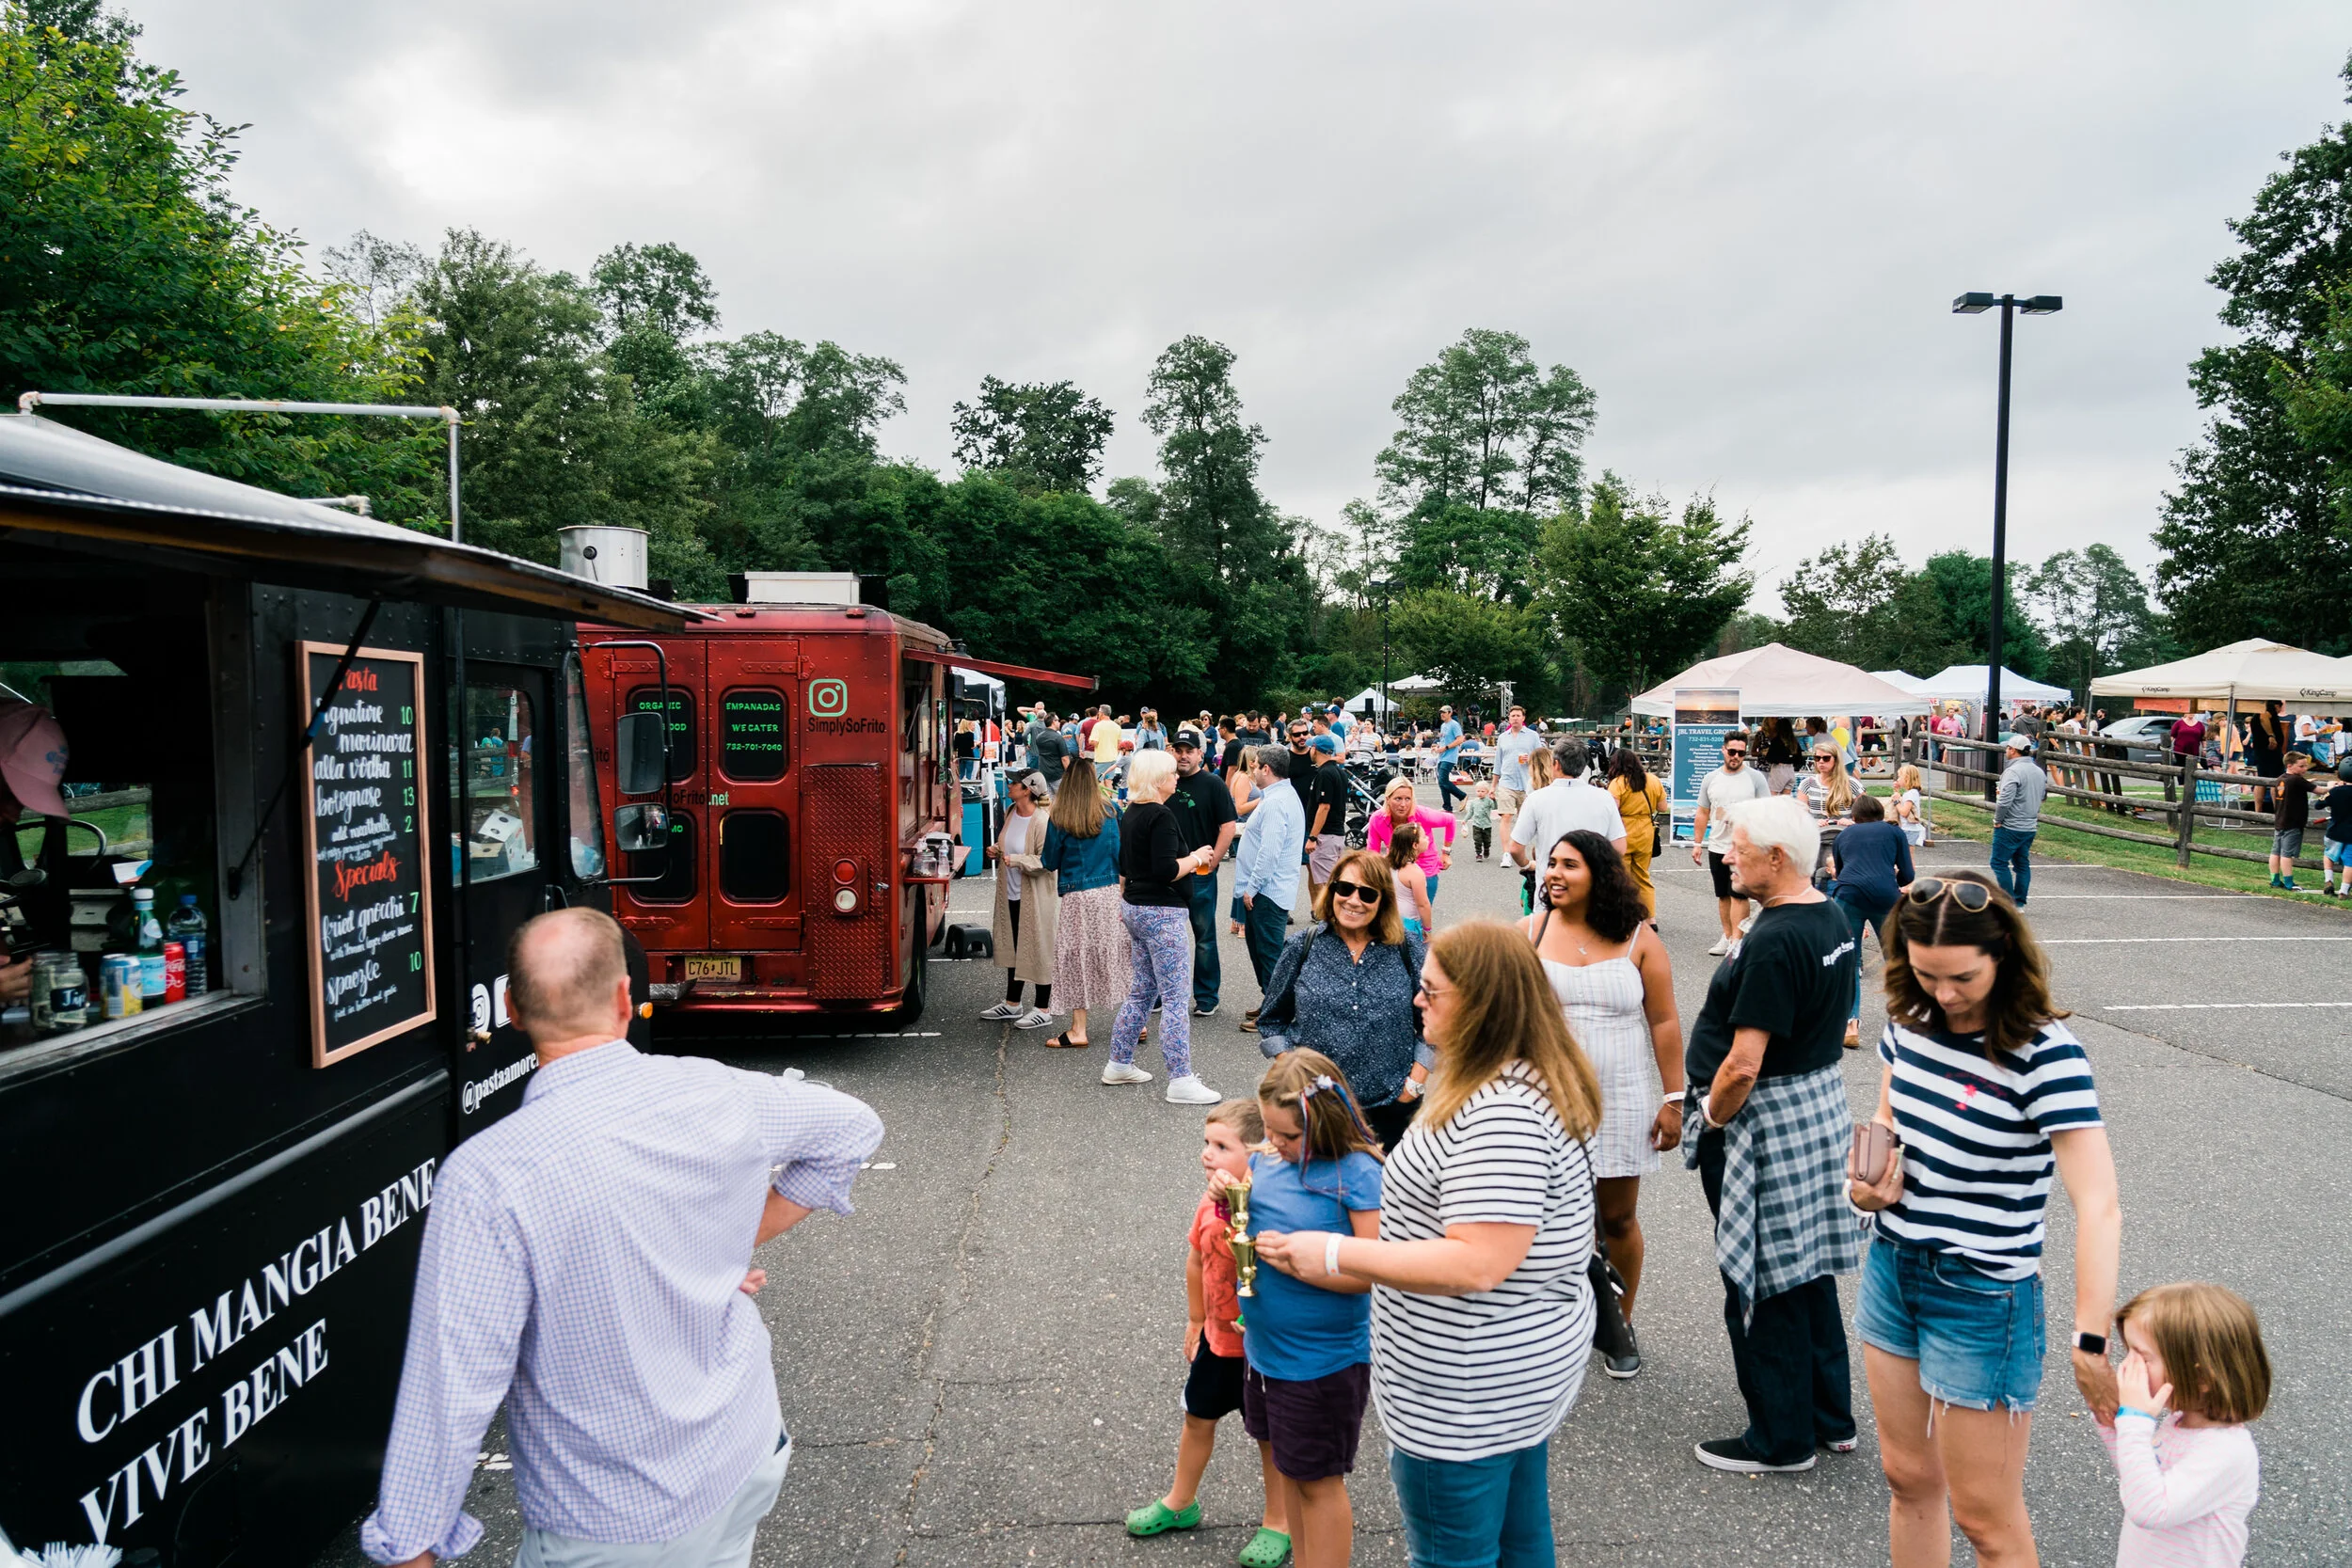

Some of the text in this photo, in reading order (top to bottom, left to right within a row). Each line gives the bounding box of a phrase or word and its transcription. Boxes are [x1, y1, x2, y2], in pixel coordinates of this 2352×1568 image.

[339, 660, 378, 691] asta
[316, 698, 413, 736] ignature 10
[725, 703, 781, 711] EMPANADAS
[731, 723, 779, 733] WE CATER
[808, 718, 886, 736] SimplySoFrito
[337, 731, 414, 753] marinara
[314, 754, 413, 780] alla vodka 11
[403, 786, 414, 806] 13
[405, 816, 413, 832] 2
[331, 850, 403, 902] Specials
[322, 892, 420, 953] fried gnocchi 7
[409, 951, 421, 972] 10
[689, 961, 738, 975] C76 JTL
[77, 1158, 436, 1444] CHI MANGIA BENE
[79, 1319, 329, 1547] VIVE BENE
